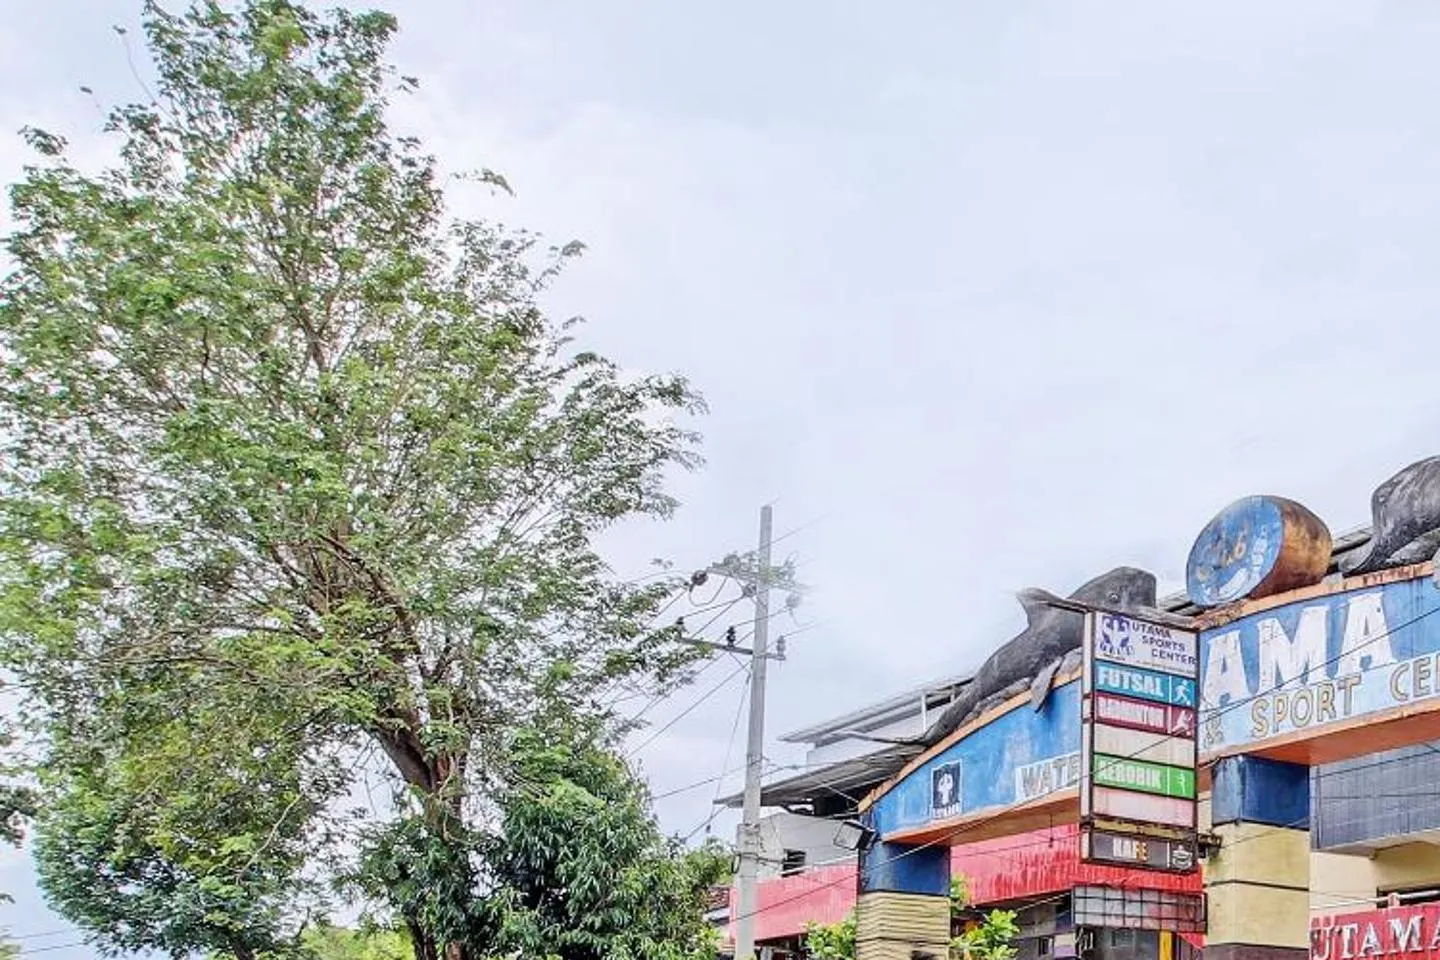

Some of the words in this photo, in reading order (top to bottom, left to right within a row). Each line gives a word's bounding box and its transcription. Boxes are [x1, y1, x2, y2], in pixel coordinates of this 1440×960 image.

[1132, 621, 1171, 639] UTAMA
[1141, 635, 1186, 652] SPORTS
[1151, 649, 1197, 665] CENTER
[1203, 592, 1398, 706] AMA
[1097, 665, 1164, 697] FUTSAL
[1250, 674, 1362, 738] SPORT
[1020, 754, 1081, 798] WATE
[1096, 760, 1161, 789] AEROBIK
